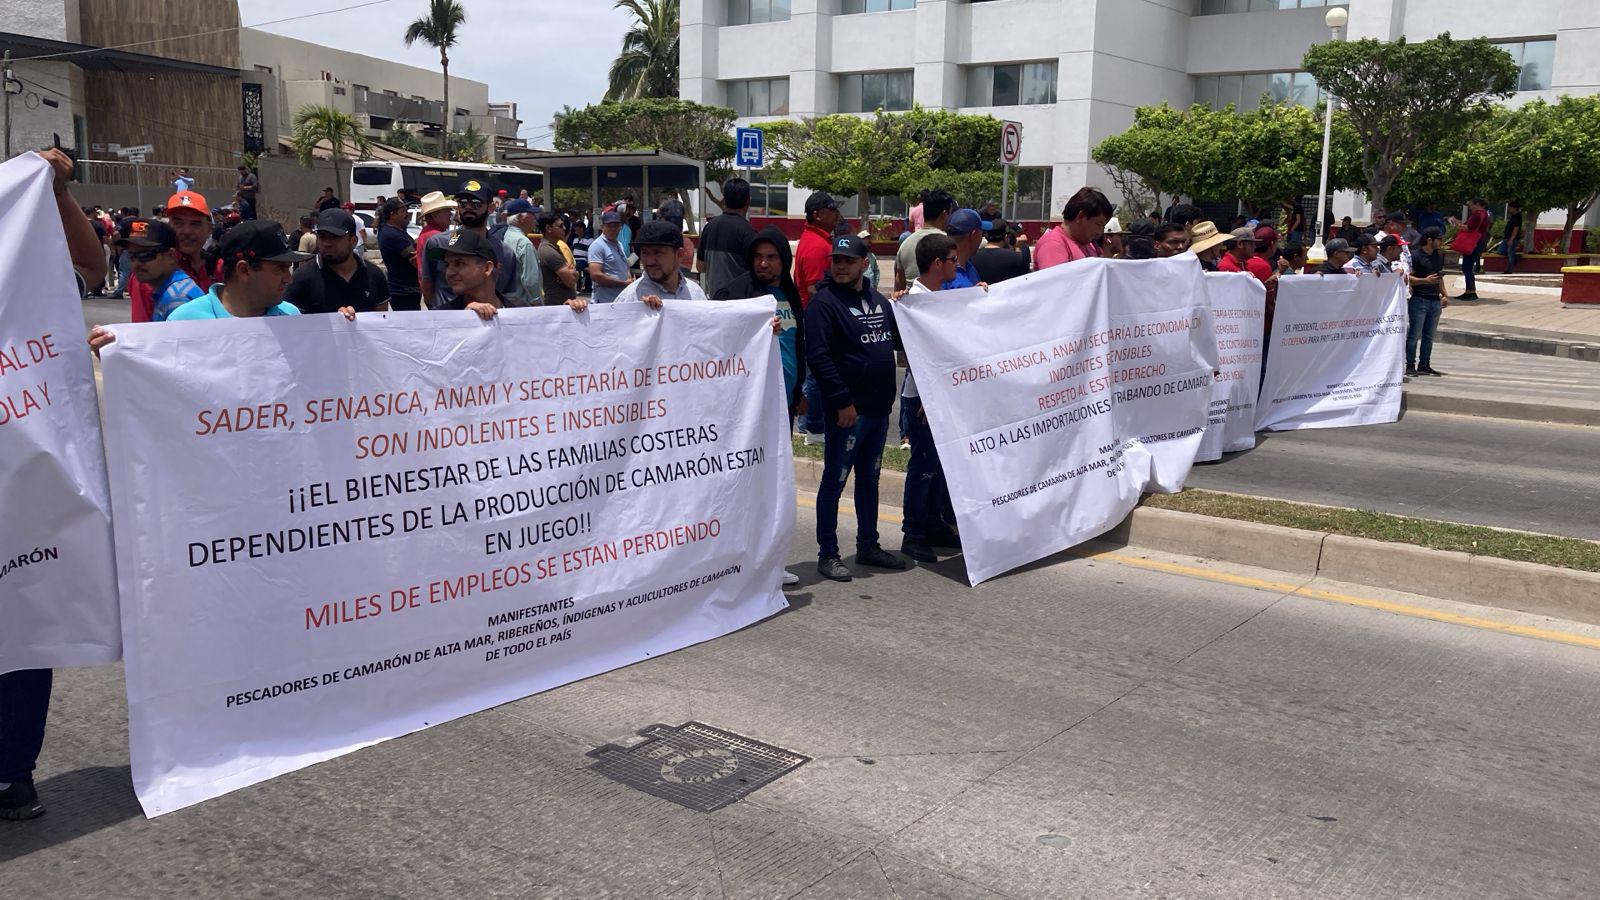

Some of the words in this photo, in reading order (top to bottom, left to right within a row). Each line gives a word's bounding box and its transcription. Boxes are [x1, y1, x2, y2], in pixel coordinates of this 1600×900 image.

[27, 334, 59, 363] DE
[952, 364, 997, 386] SADER,
[997, 351, 1051, 374] SENASICA,
[1053, 339, 1082, 359] ANAM
[1134, 325, 1146, 338] DE
[1049, 356, 1103, 383] INDOLENTES
[37, 381, 51, 406] Y
[195, 403, 295, 436] SADER,
[304, 391, 427, 424] SENASICA,
[435, 385, 496, 411] ANAM
[503, 383, 513, 402] Y
[519, 367, 629, 401] SECRETARÍA
[634, 368, 652, 388] DE
[658, 354, 750, 384] ECONOMÍA,
[1038, 387, 1077, 410] RESPETO
[1079, 384, 1088, 397] AL
[1121, 363, 1166, 380] DERECHO
[356, 432, 408, 460] SON
[416, 416, 539, 452] INDOLENTES
[547, 414, 556, 433] E
[563, 399, 667, 431] INSENSIBLES
[969, 436, 996, 456] ALTO
[999, 433, 1008, 447] A
[1010, 425, 1031, 444] LAS
[1032, 399, 1111, 437] IMPORTACIONES
[1164, 381, 1176, 395] DE
[289, 482, 338, 513] ¡¡EL
[346, 463, 470, 501] BIENESTAR
[475, 458, 502, 482] DE
[507, 452, 542, 477] LAS
[547, 436, 627, 470] FAMILIAS
[630, 424, 718, 454] COSTERAS
[992, 487, 1029, 508] PESCADORES
[1029, 484, 1038, 494] DE
[1038, 472, 1067, 490] CAMARÓN
[1067, 469, 1075, 479] DE
[1076, 465, 1088, 476] ALTA
[1088, 459, 1109, 472] MAR,
[1141, 432, 1168, 444] CULTORES
[1168, 432, 1176, 440] DE
[188, 513, 394, 567] DEPENDIENTES
[403, 507, 433, 533] DE
[441, 502, 468, 526] LA
[475, 475, 600, 520] PRODUCCIÓN
[605, 472, 627, 494] DE
[631, 453, 722, 488] CAMARÓN
[727, 447, 765, 470] ESTAN
[485, 532, 511, 555] EN
[518, 512, 592, 549] JUEGO!!
[305, 594, 382, 629] MILES
[391, 586, 421, 613] DE
[429, 562, 531, 604] EMPLEOS
[537, 556, 558, 580] SE
[563, 541, 618, 573] ESTAN
[623, 519, 721, 558] PERDIENDO
[226, 676, 319, 708] PESCADORES
[322, 671, 340, 686] DE
[343, 653, 411, 680] CAMARÓN
[414, 649, 431, 663] DE
[433, 641, 461, 659] ALTA
[464, 631, 494, 650] MAR,
[497, 612, 560, 642] RIBEREÑOS,
[562, 602, 616, 626] ÍNDIGENAS
[618, 600, 624, 611] Y
[626, 581, 688, 608] ACUICULTORES
[689, 578, 700, 589] DE
[701, 565, 741, 585] CAMARÓN
[488, 596, 575, 627] MANIFESTANTES
[485, 650, 500, 662] DE
[503, 640, 534, 657] TODO
[537, 637, 547, 648] EL
[550, 629, 572, 647] PAÍS
